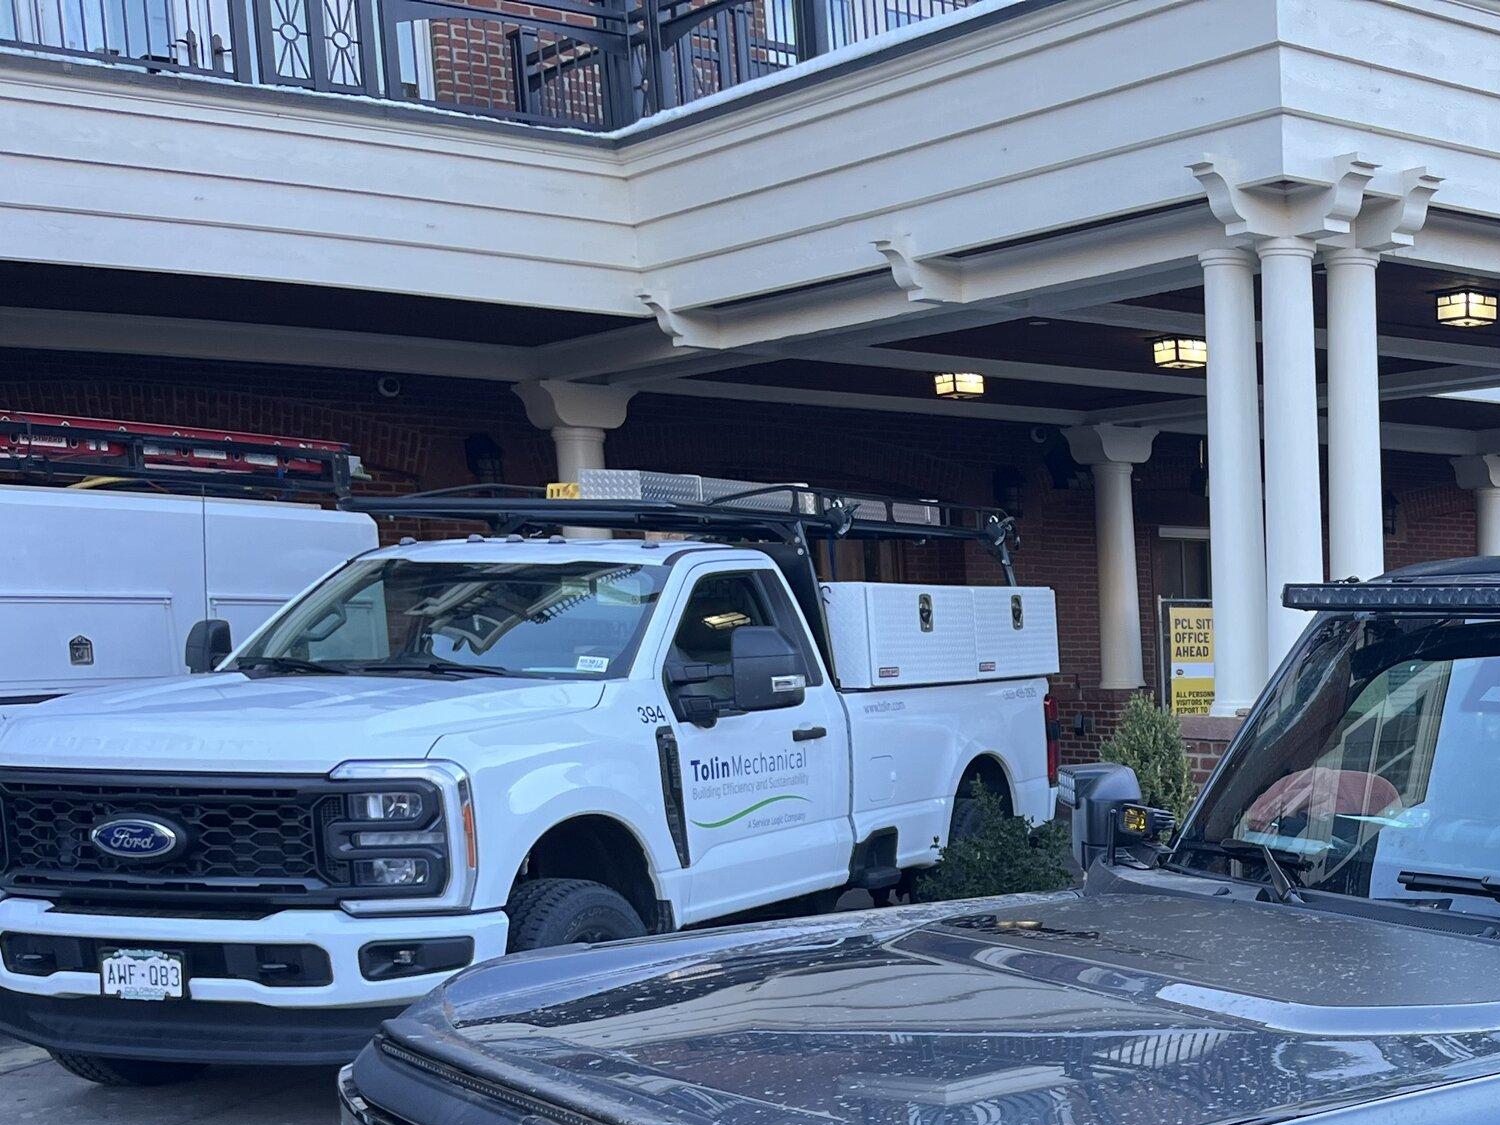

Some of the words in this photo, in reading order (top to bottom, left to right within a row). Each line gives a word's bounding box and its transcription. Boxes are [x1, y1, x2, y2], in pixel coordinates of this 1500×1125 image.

[1174, 618, 1194, 630] PCL
[1174, 632, 1210, 644] OFFICE
[1175, 646, 1209, 657] AHEAD
[637, 705, 666, 724] 394
[692, 785, 721, 800] Building
[722, 780, 755, 796] Efficiency
[755, 779, 768, 790] and
[769, 772, 809, 789] Sustainability
[110, 826, 155, 849] Ford
